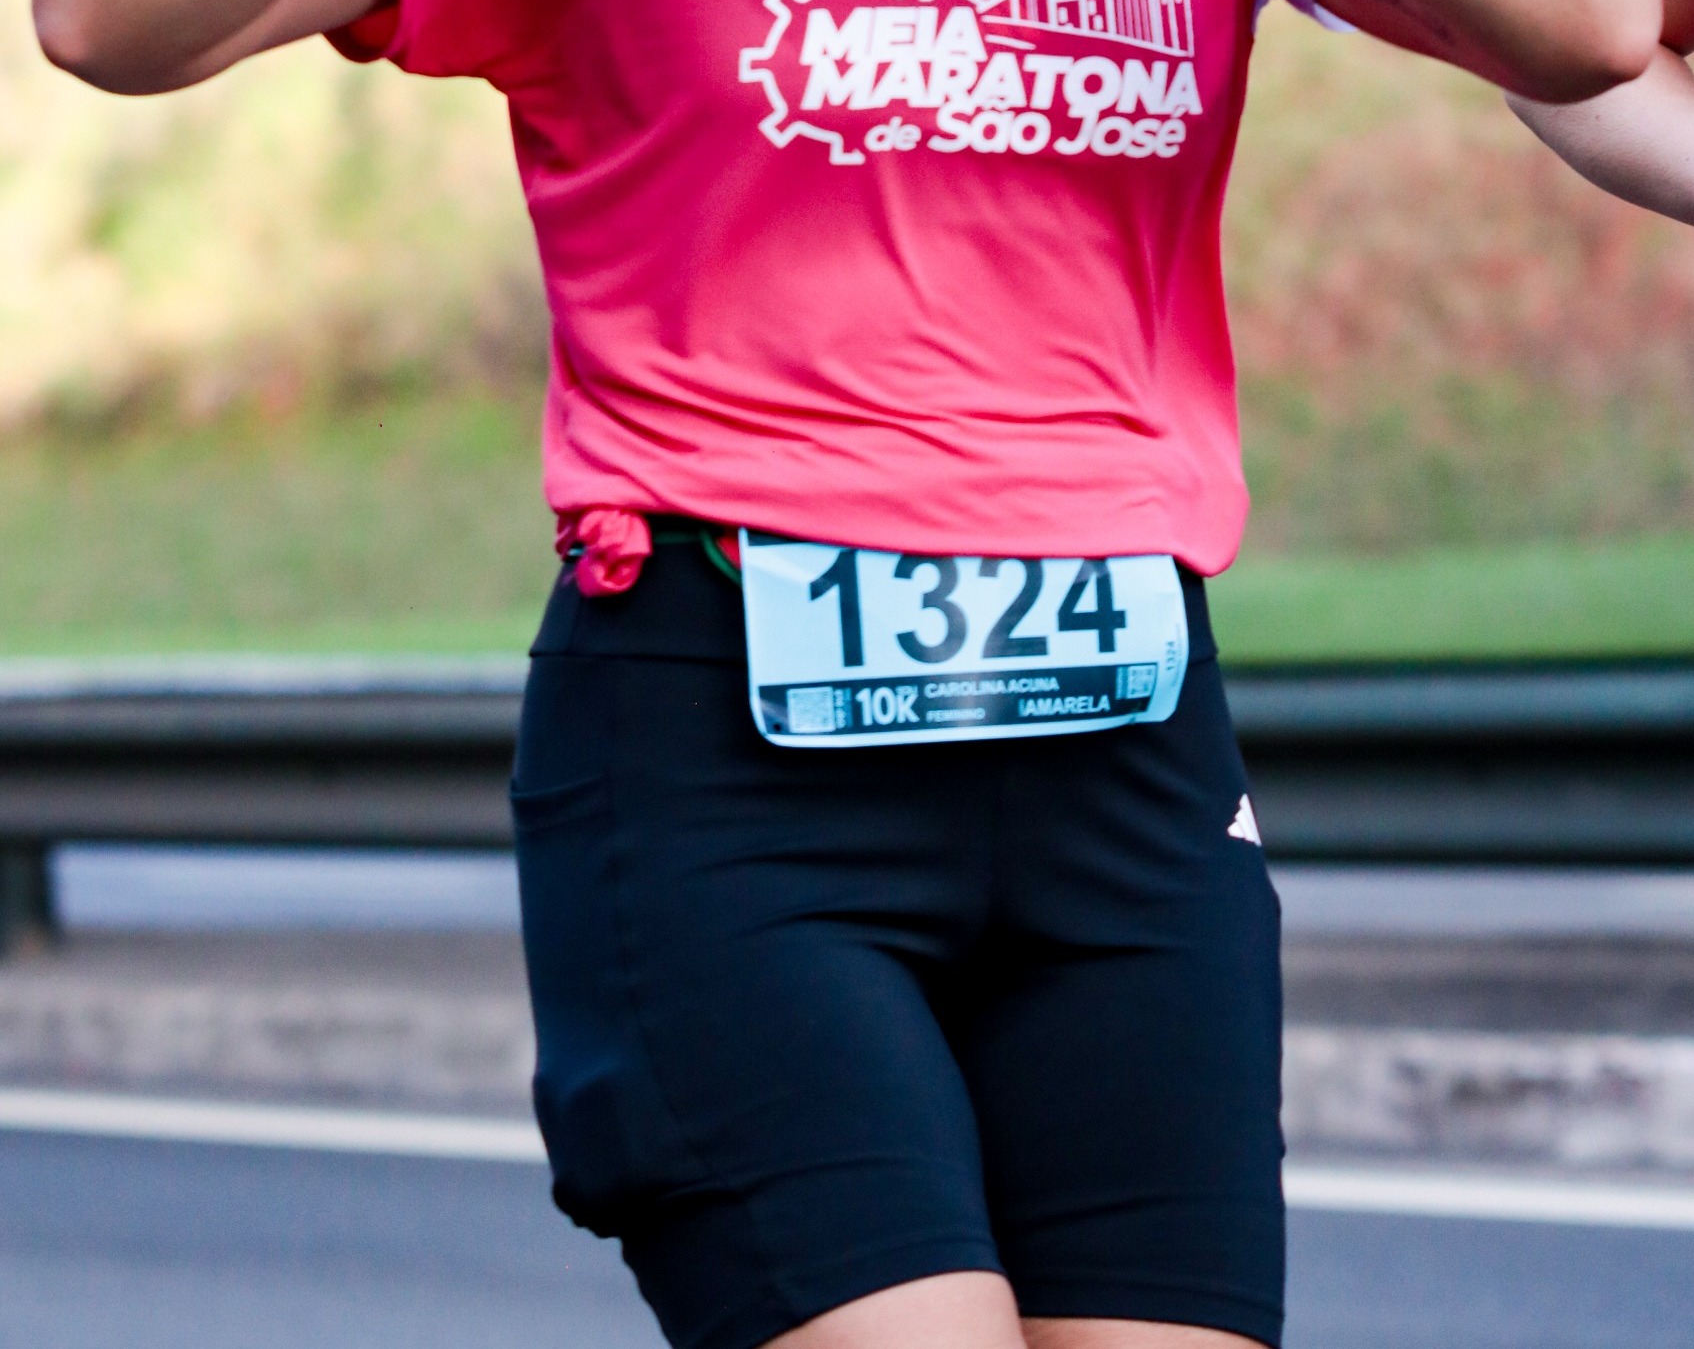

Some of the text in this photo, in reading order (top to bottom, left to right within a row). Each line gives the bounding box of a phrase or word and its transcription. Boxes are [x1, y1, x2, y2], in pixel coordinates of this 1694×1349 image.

[800, 5, 988, 64] MEIA
[800, 52, 1202, 115] MARATONA
[864, 97, 1187, 158] de São José
[810, 548, 1126, 667] 1324
[855, 686, 920, 726] 10K
[924, 679, 1006, 698] CAROLINA
[1024, 695, 1111, 717] AMARELA
